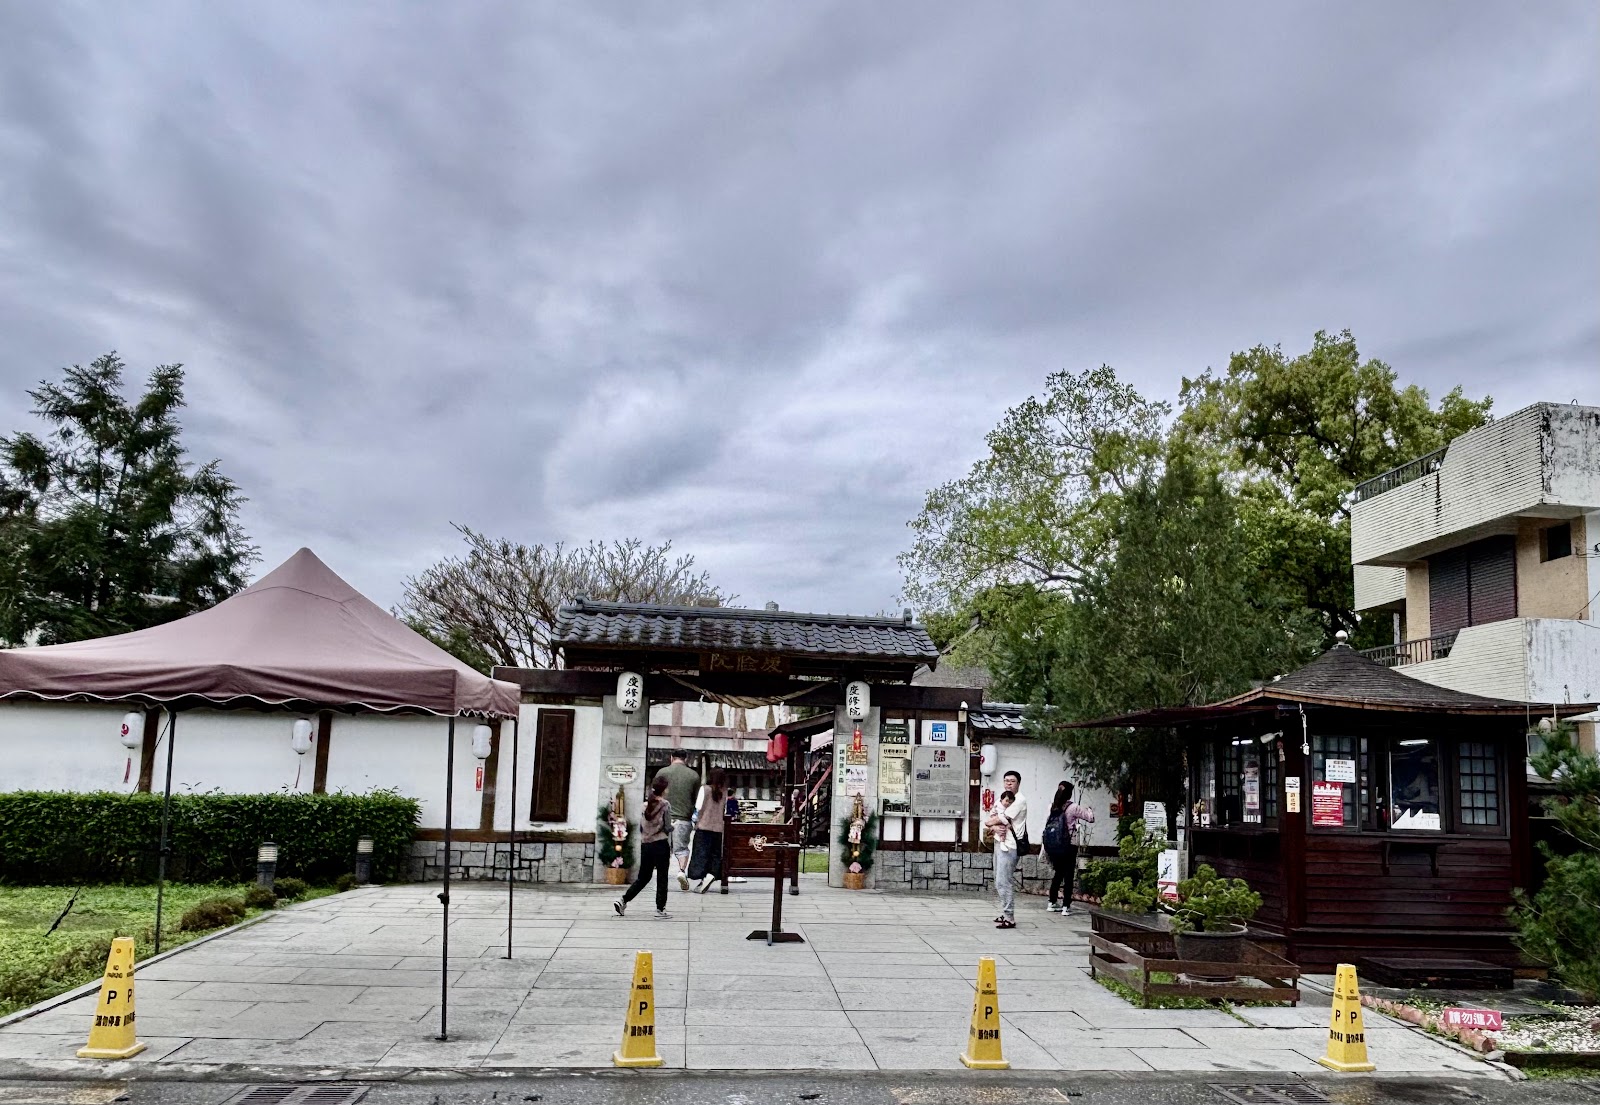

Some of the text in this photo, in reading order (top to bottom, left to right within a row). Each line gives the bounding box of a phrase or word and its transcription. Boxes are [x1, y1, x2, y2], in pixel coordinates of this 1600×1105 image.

[106, 990, 117, 1004] P
[639, 1001, 648, 1015] P
[985, 1006, 993, 1020] P
[95, 1014, 121, 1027] 請勿停車
[1335, 1009, 1341, 1022] P
[1350, 1011, 1357, 1024] P
[1448, 1011, 1499, 1027] 請勿進入
[978, 1029, 999, 1040] 請勿停車
